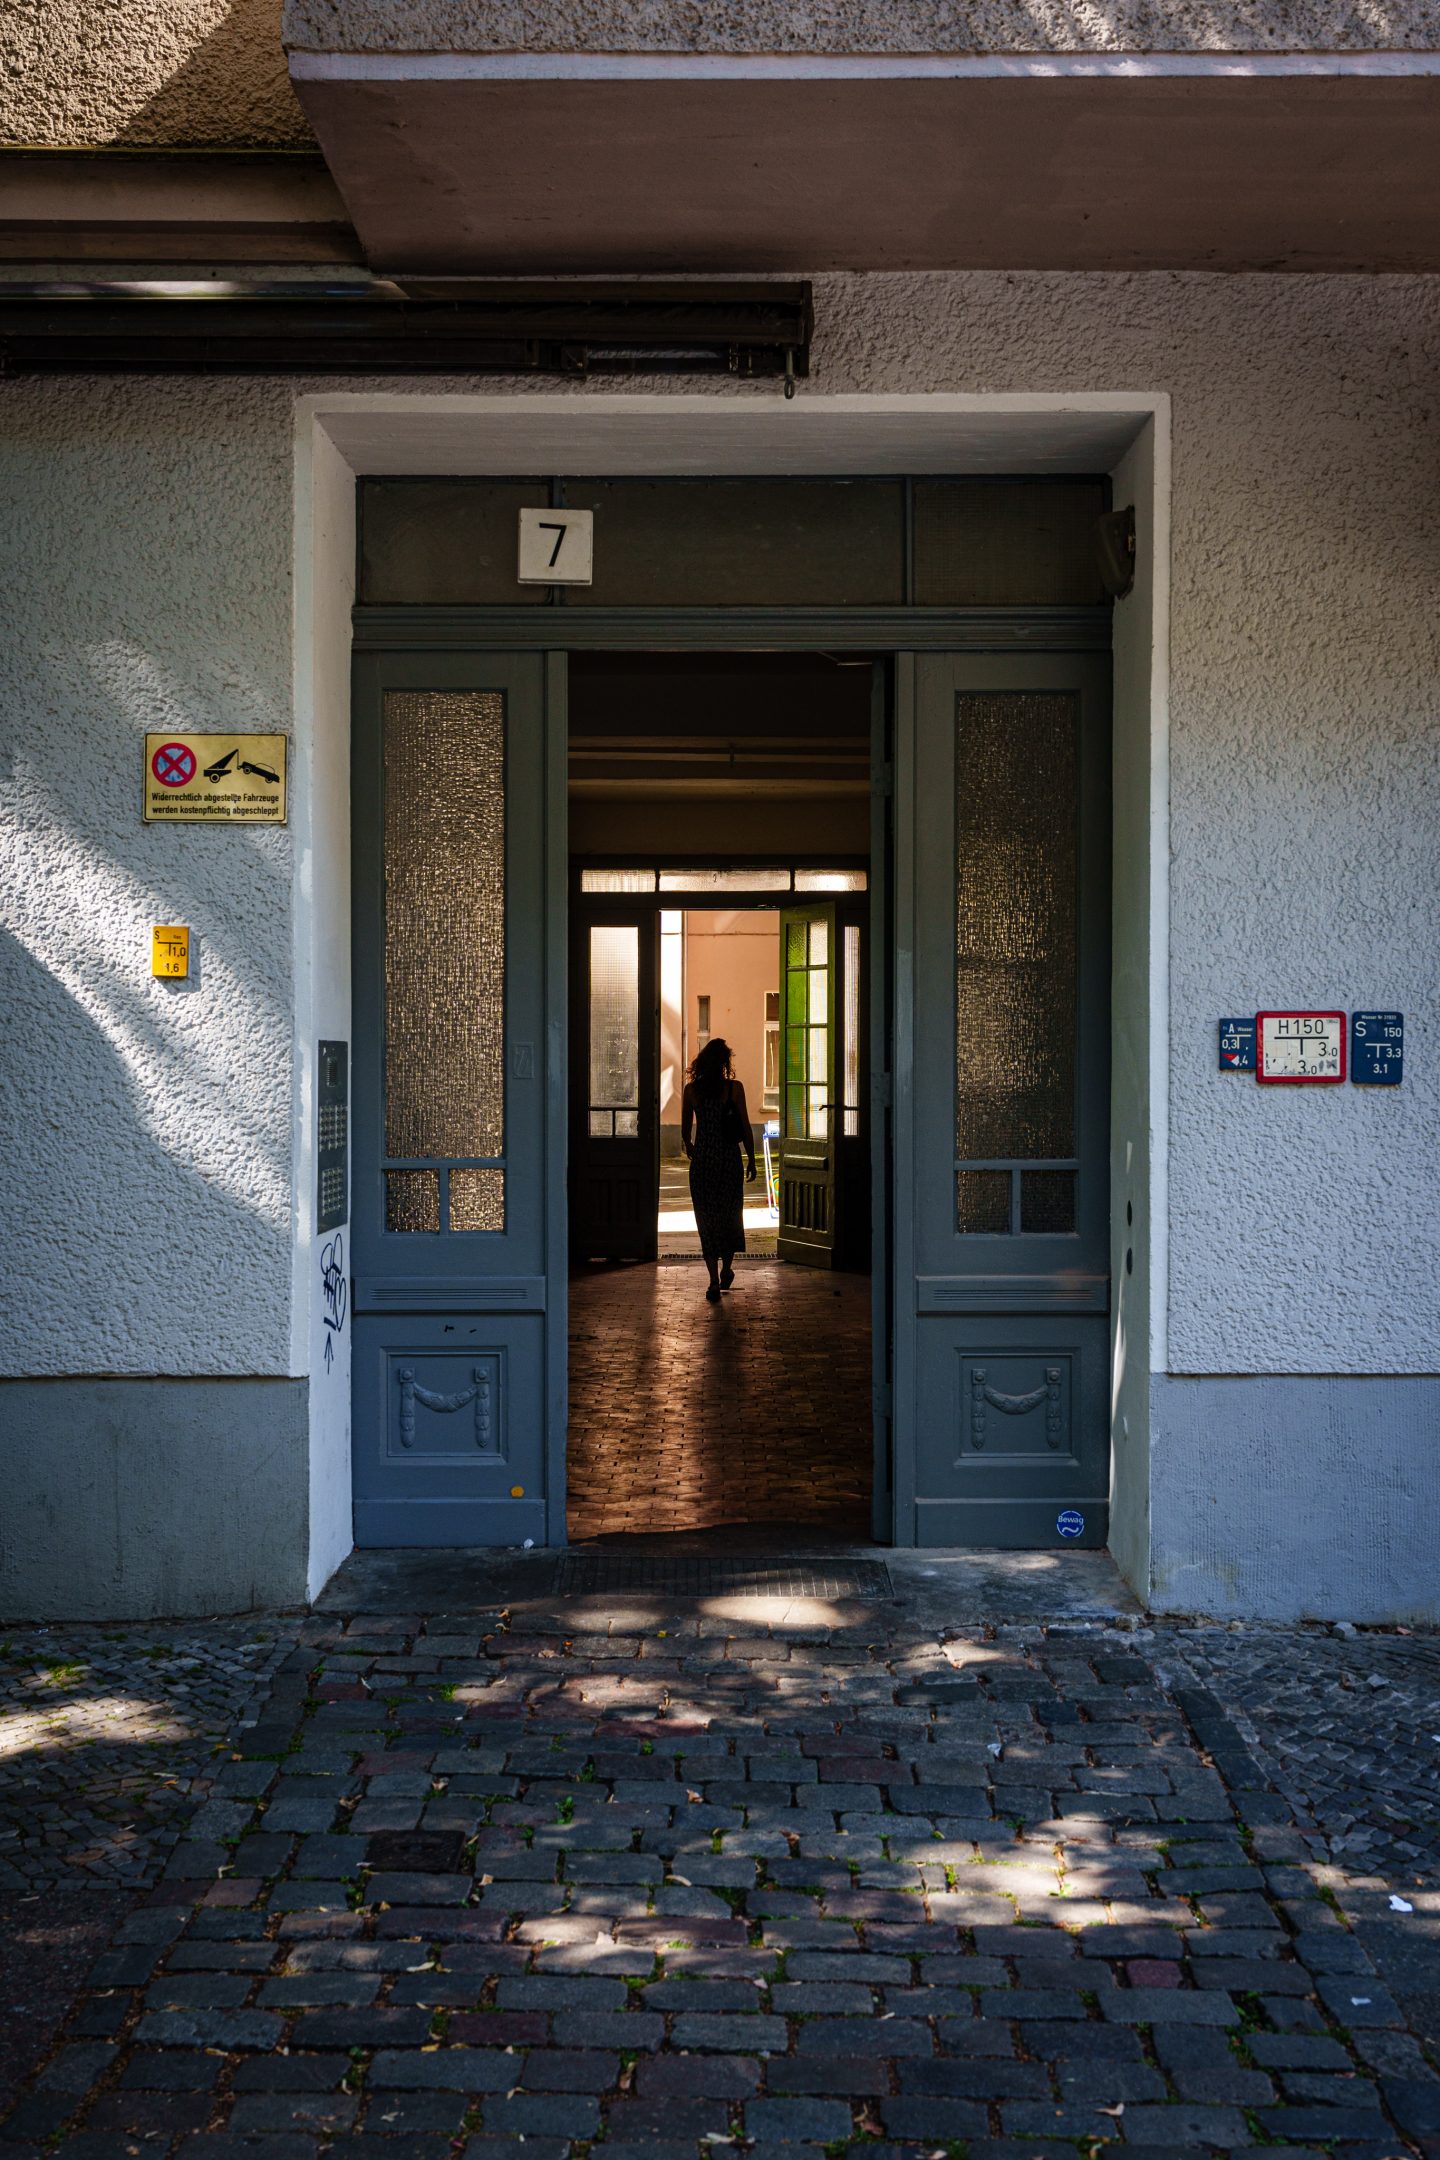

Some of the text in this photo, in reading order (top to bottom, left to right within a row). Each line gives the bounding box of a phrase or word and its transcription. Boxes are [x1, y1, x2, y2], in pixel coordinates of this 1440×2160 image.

[538, 522, 568, 567] 7
[152, 792, 202, 801] Widerrechtlich
[244, 793, 279, 804] Fahrzeuge
[152, 805, 279, 816] werden kostenpflichtig abgeschleppt
[1355, 1021, 1402, 1038] S 150
